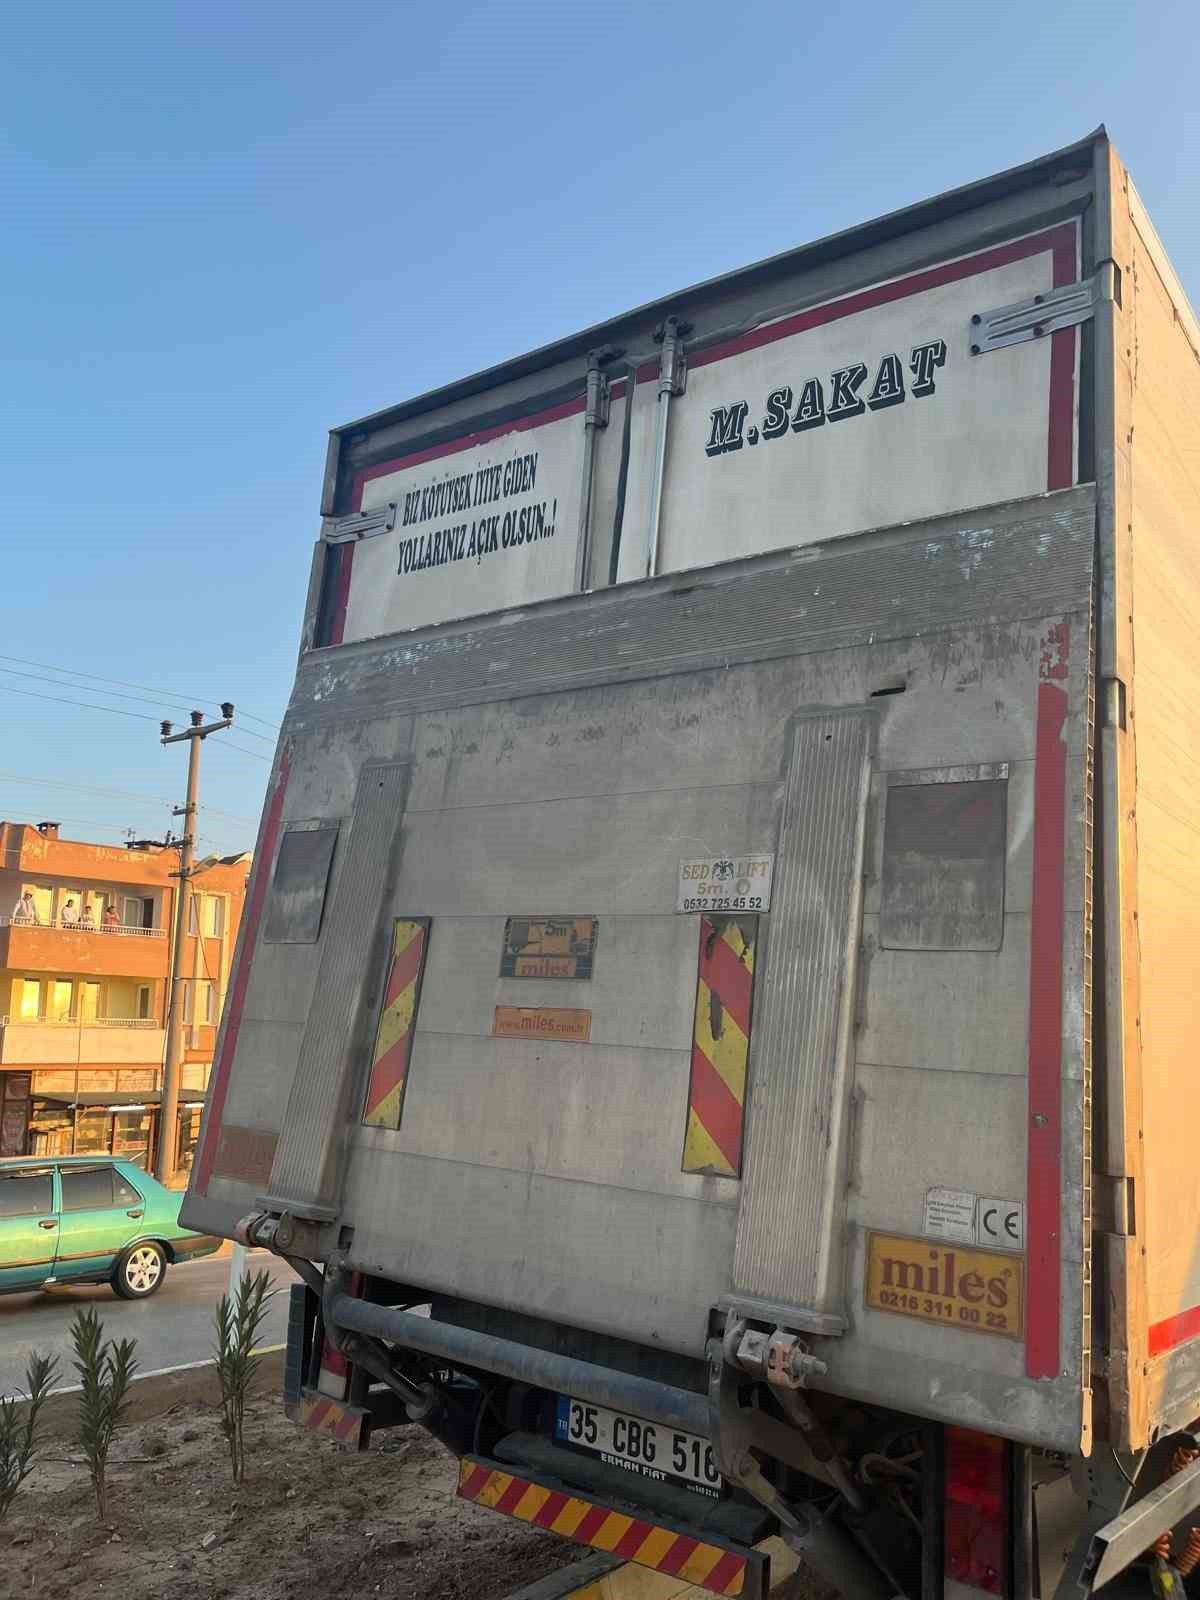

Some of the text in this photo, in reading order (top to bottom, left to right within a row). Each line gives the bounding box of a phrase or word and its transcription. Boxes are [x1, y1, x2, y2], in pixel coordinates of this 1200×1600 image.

[402, 448, 538, 527] BİZ KÖTÜYSEK İYİYE GİDEN
[397, 524, 467, 575] YOLLARINIZ
[466, 514, 500, 565] AÇIK
[682, 864, 709, 880] SED
[683, 899, 708, 910] 0532
[520, 957, 569, 977] miles
[880, 1250, 1008, 1308] miles
[880, 1290, 918, 1310] 0216
[924, 1299, 952, 1317] 311
[986, 1312, 1007, 1328] 22
[570, 1404, 598, 1444] 35
[613, 1417, 656, 1463] CBG
[601, 1453, 666, 1481] ERMAN FIAT
